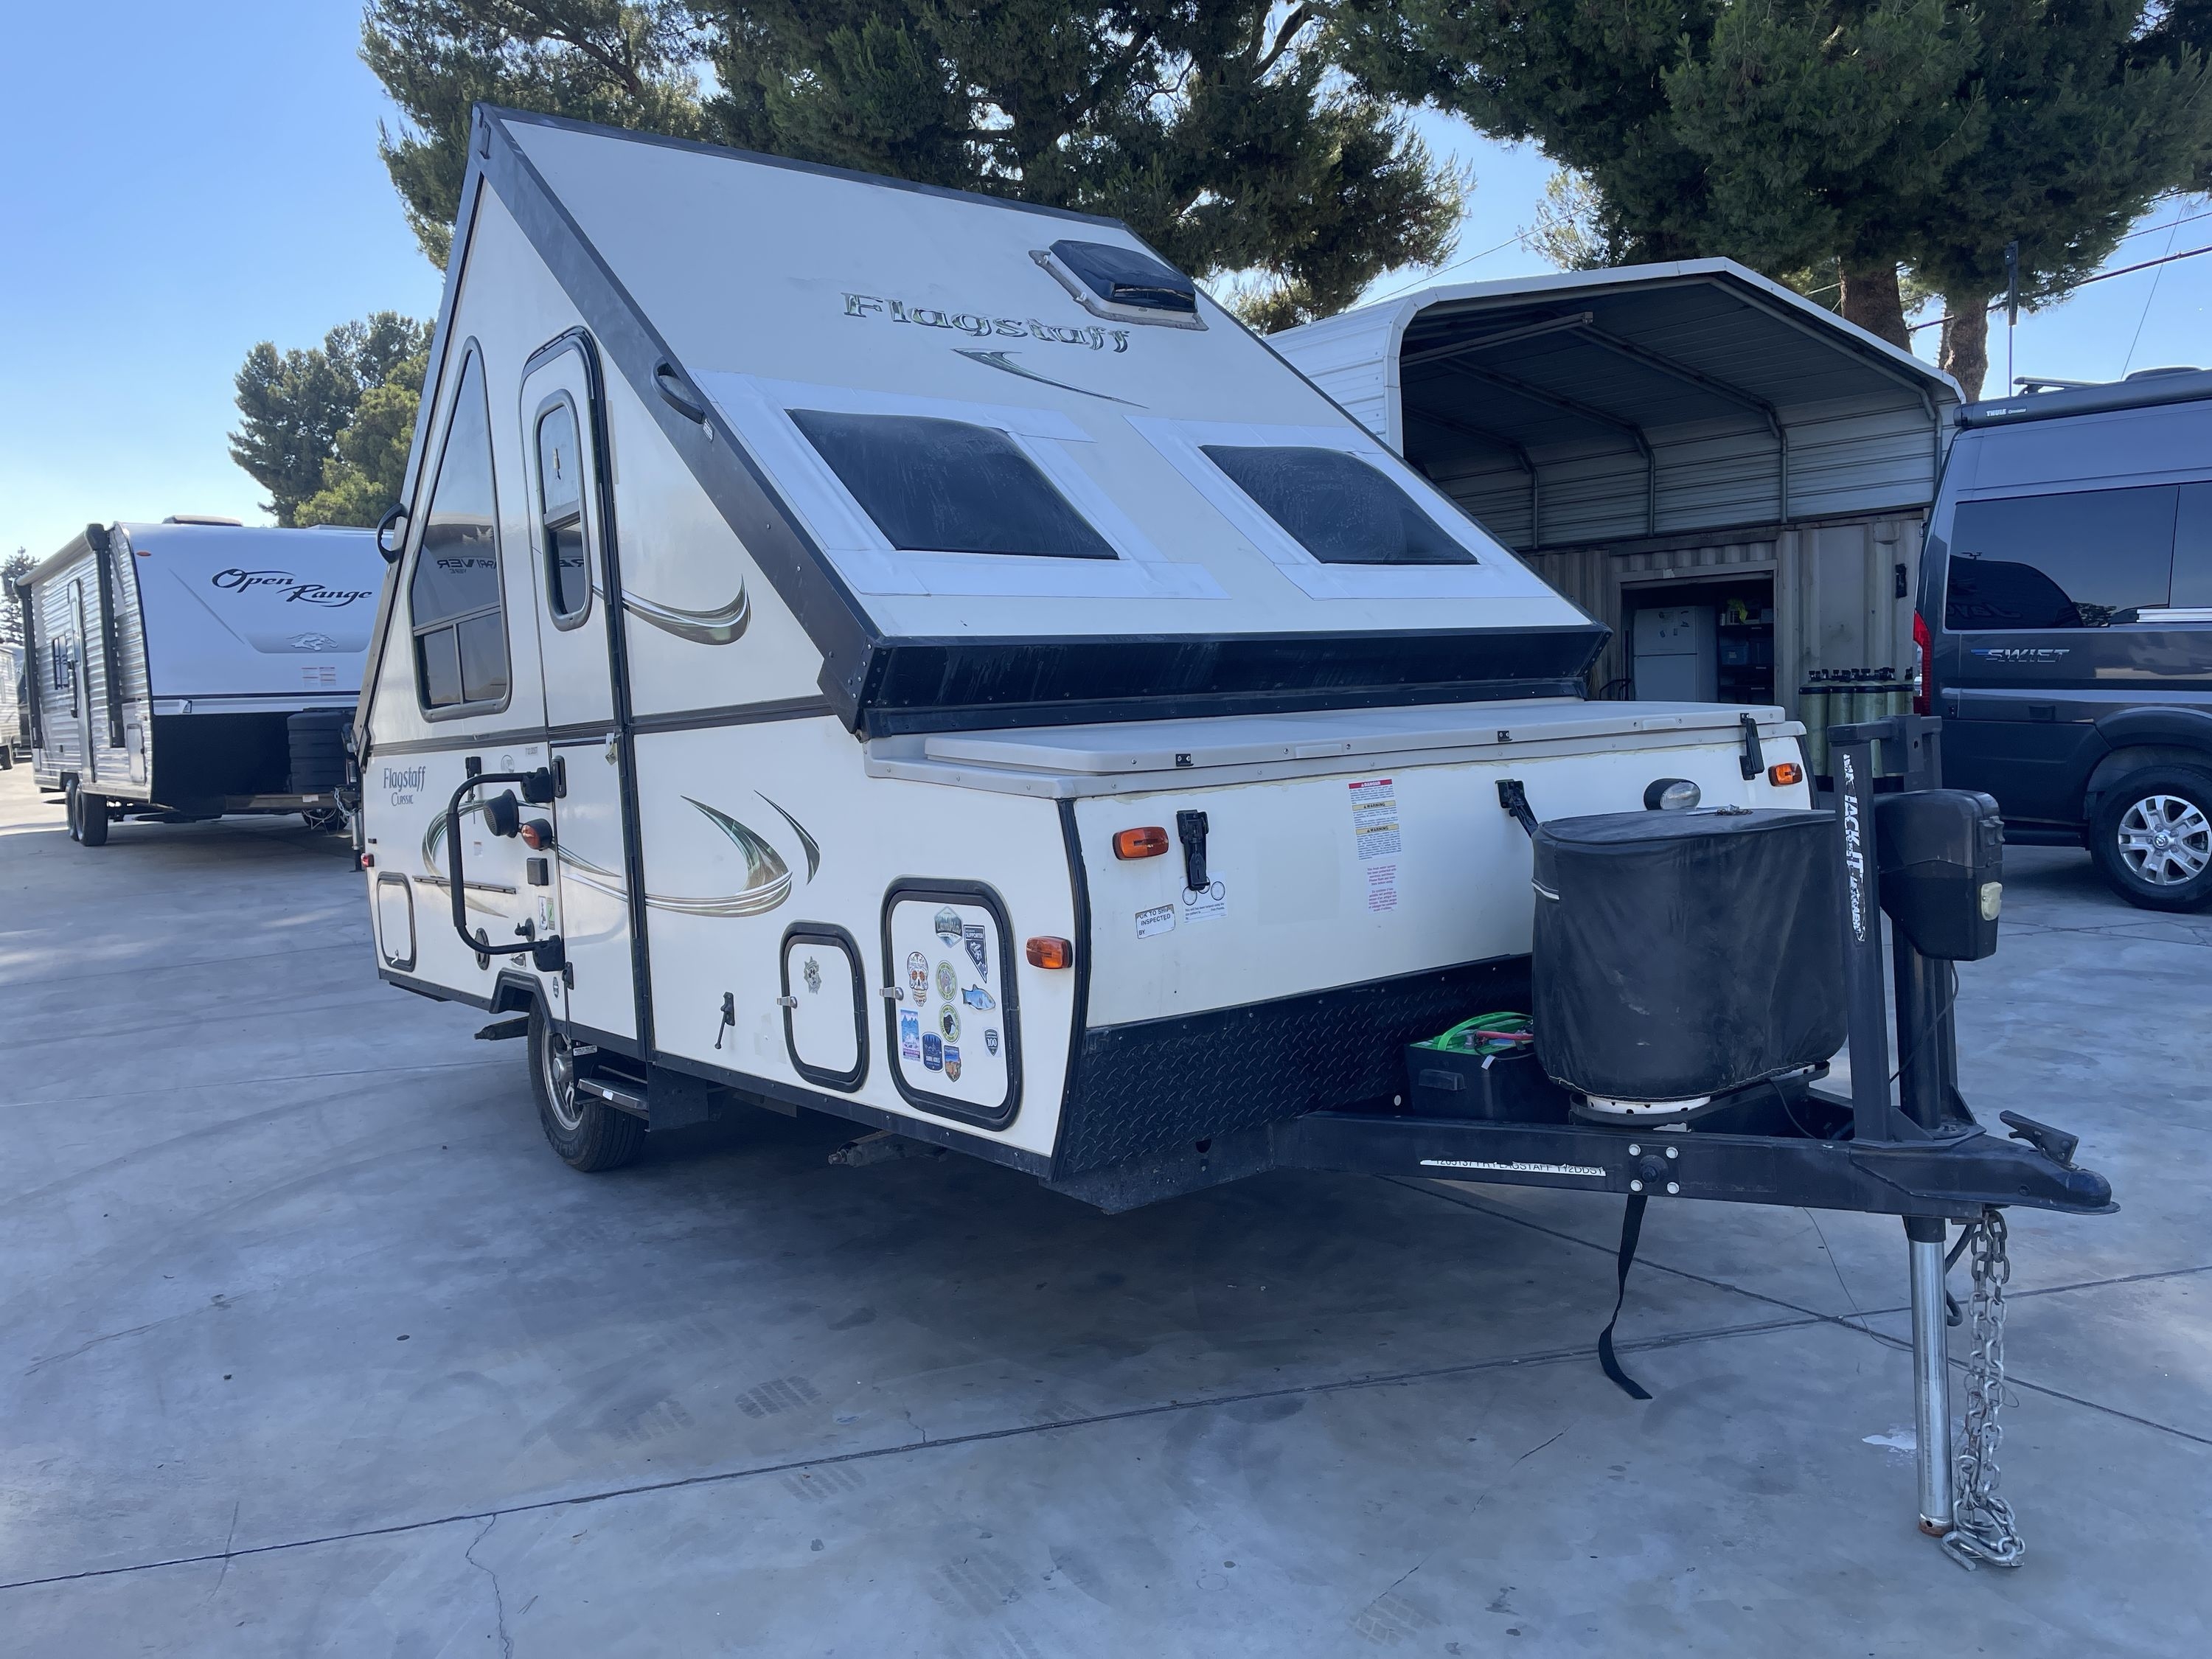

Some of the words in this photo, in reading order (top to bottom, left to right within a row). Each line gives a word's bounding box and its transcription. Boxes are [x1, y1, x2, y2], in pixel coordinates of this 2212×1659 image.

[841, 292, 1130, 353] Flagstaff
[1986, 408, 2006, 417] THULE
[212, 568, 296, 593] Open
[276, 584, 372, 607] Range
[383, 765, 426, 793] Flagstaff
[1141, 914, 1171, 925] INSPECTED
[987, 1038, 998, 1046] 100
